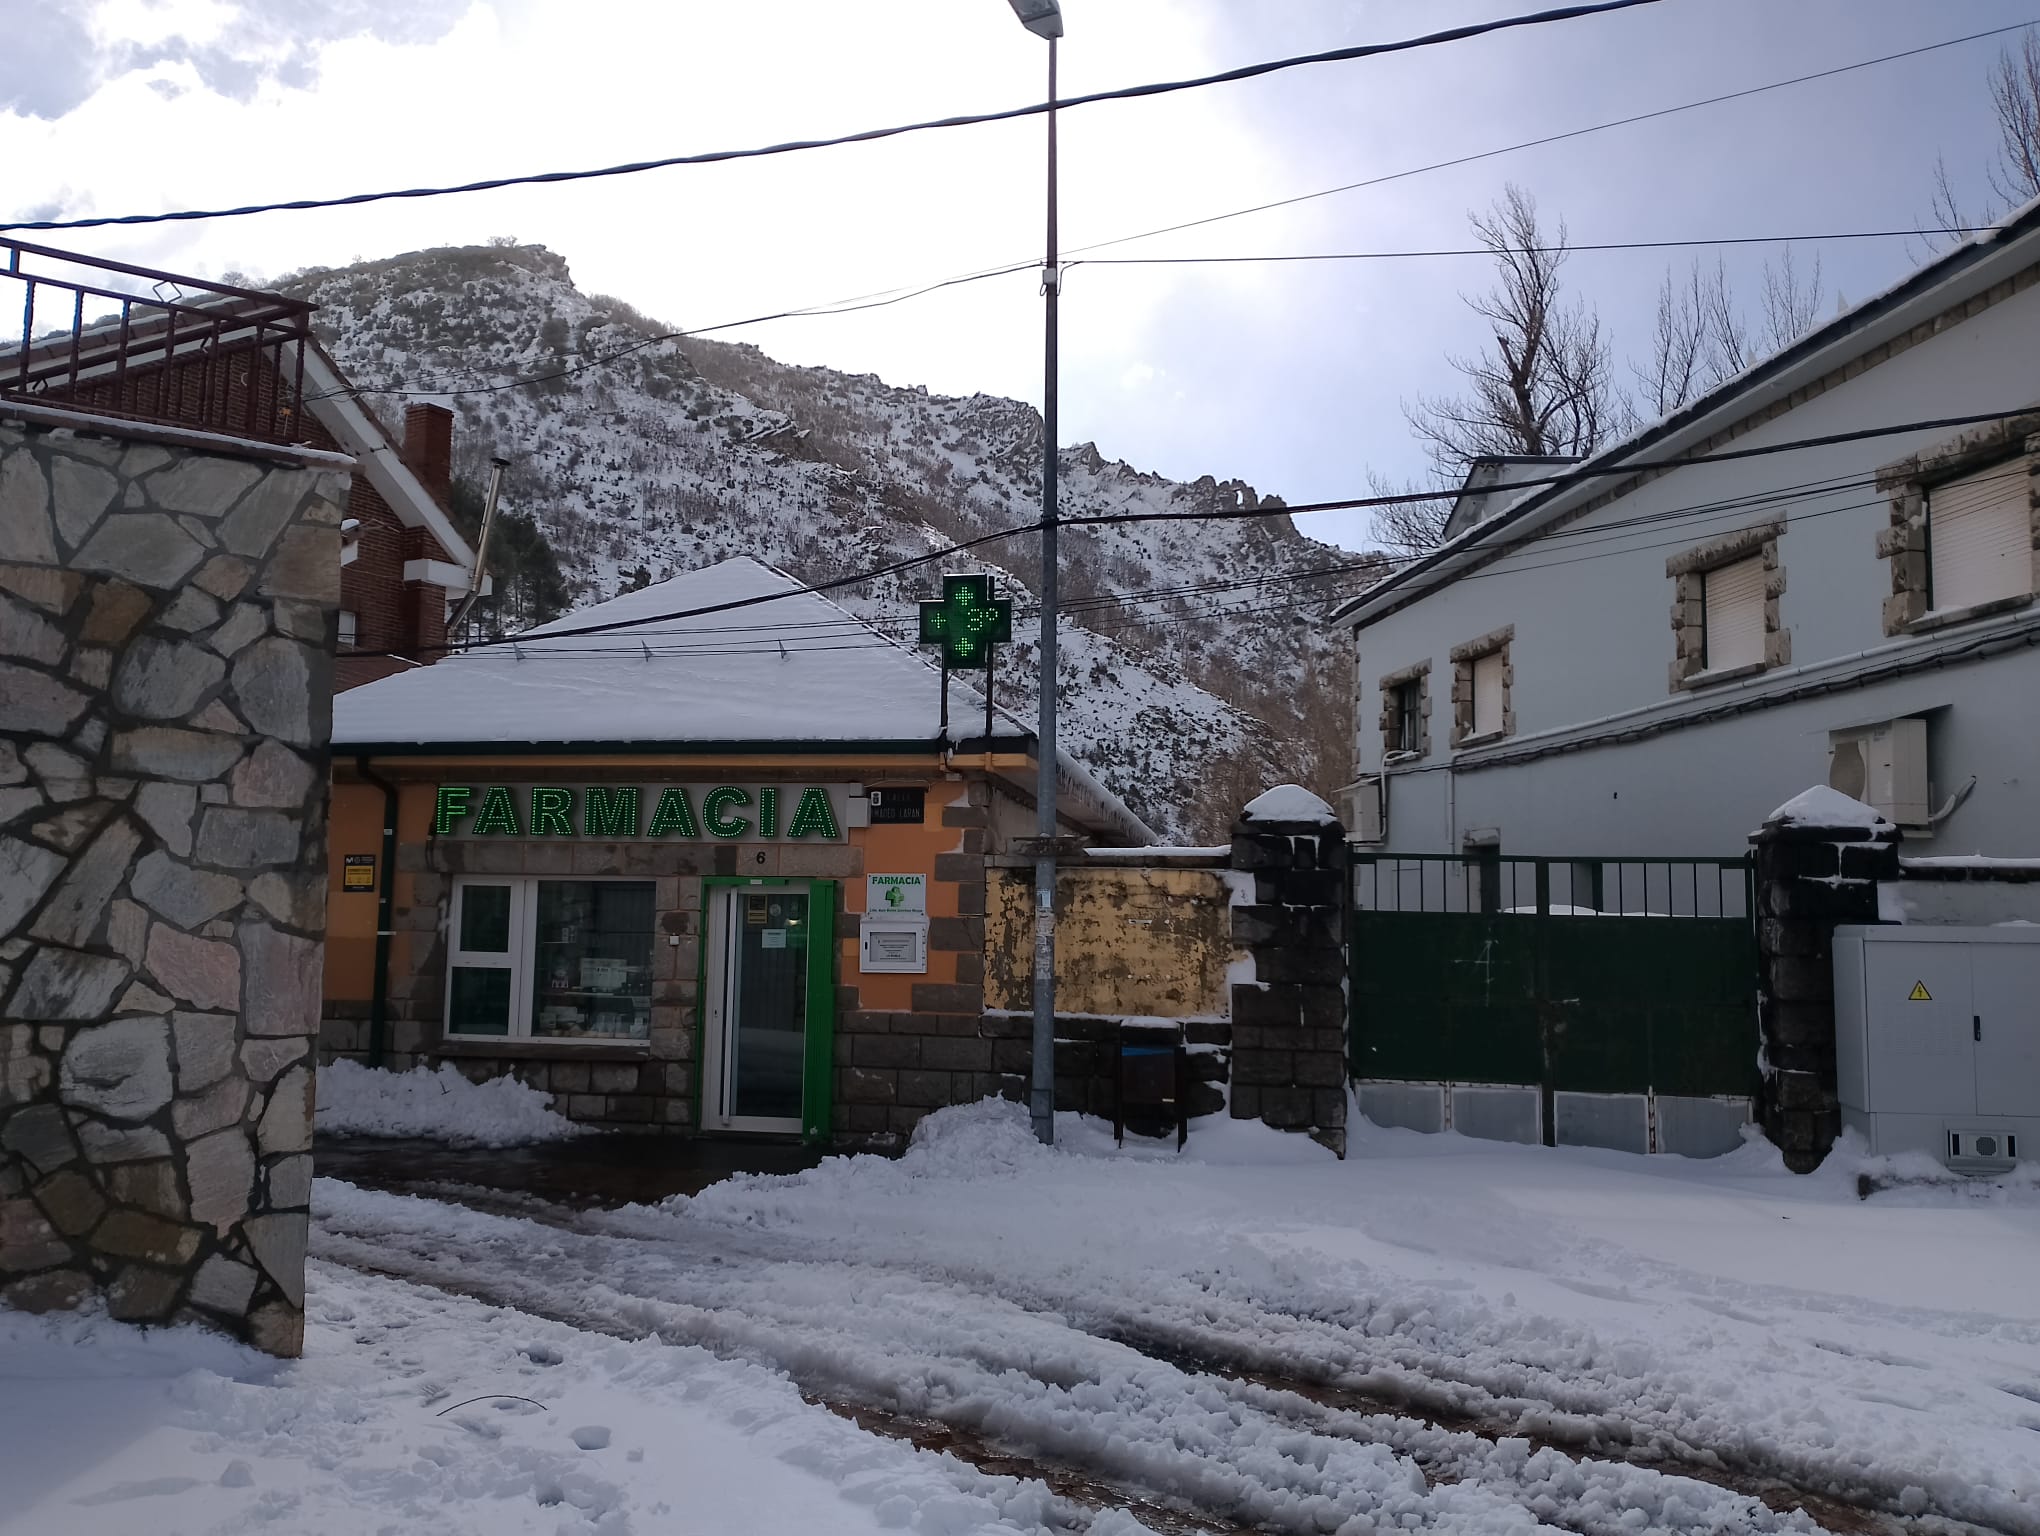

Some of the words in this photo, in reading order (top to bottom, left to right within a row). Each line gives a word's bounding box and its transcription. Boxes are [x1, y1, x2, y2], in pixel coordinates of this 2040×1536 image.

[436, 786, 838, 838] FARMACIA
[756, 852, 766, 864] 6
[872, 876, 921, 885] FARMACIA
